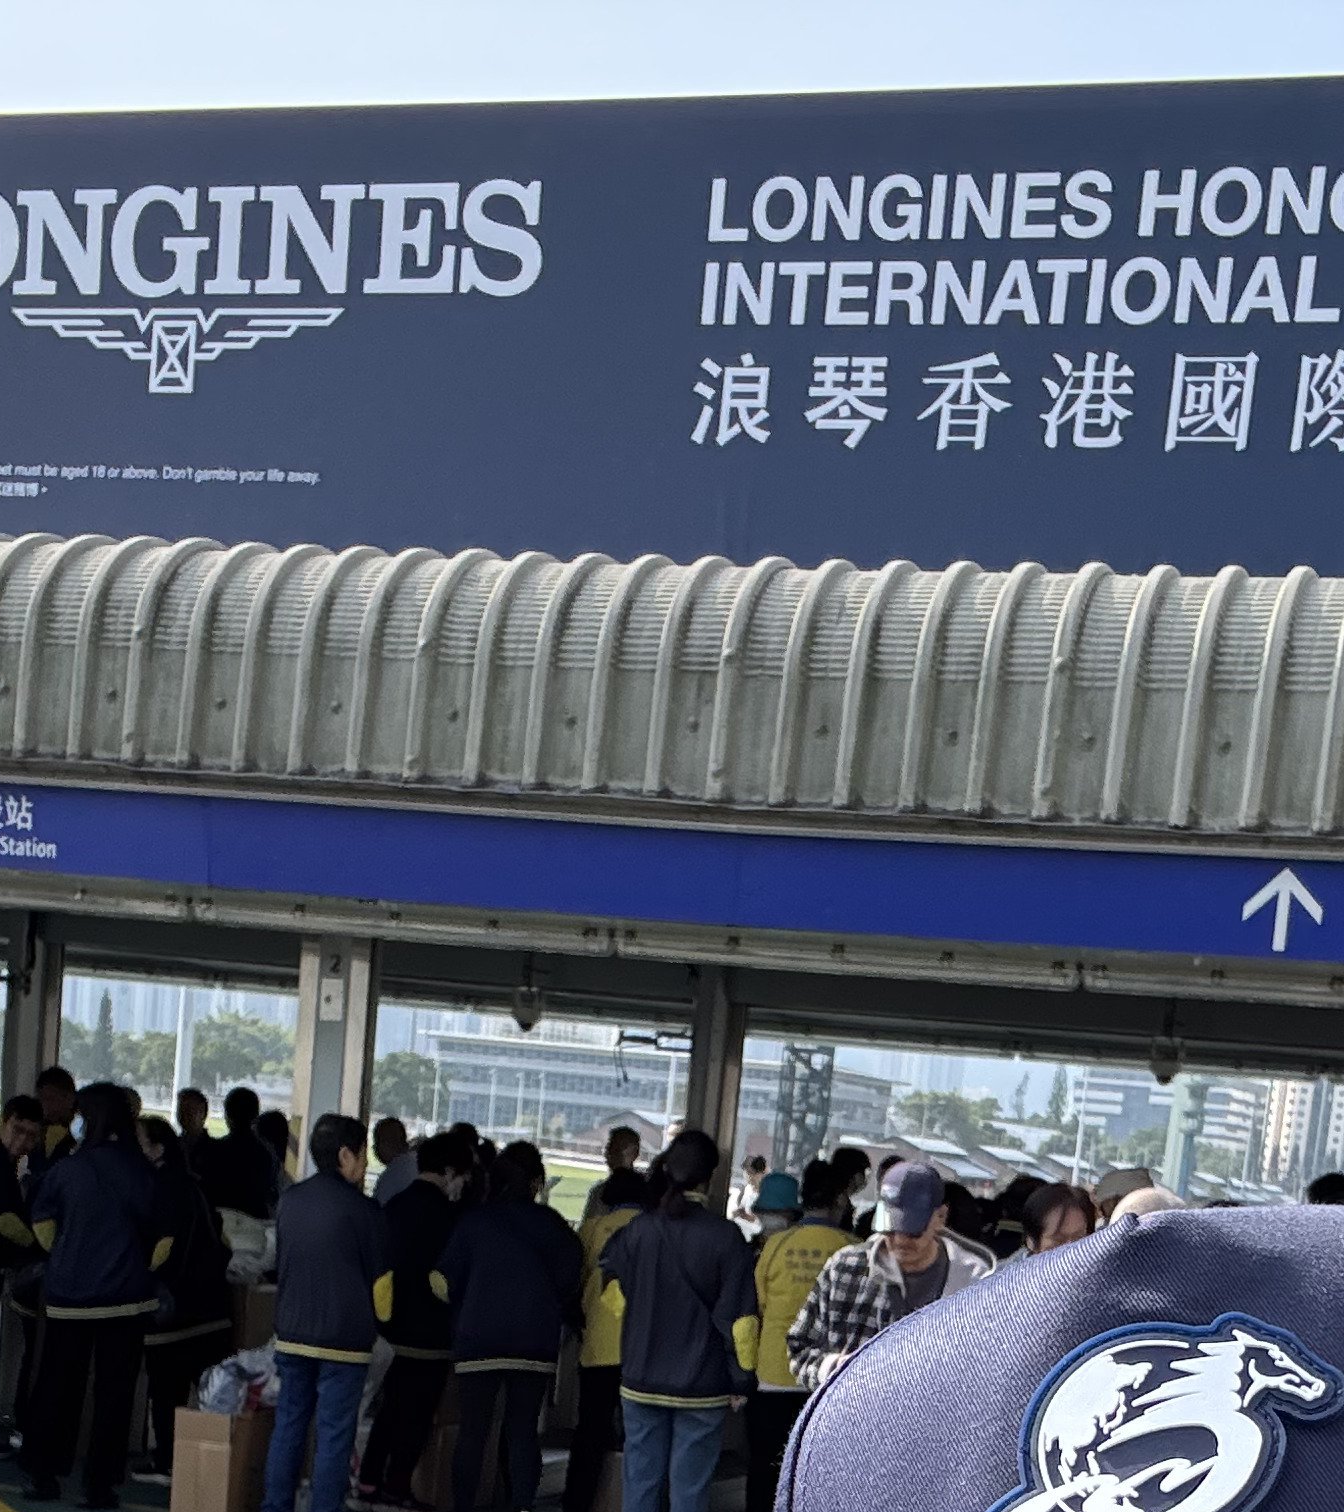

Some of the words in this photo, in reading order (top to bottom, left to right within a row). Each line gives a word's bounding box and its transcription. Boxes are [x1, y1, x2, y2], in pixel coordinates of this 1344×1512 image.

[707, 169, 1114, 243] LONGINES
[700, 255, 1341, 326] INTERNATIONAL
[0, 835, 57, 860] Station
[329, 954, 342, 974] 2
